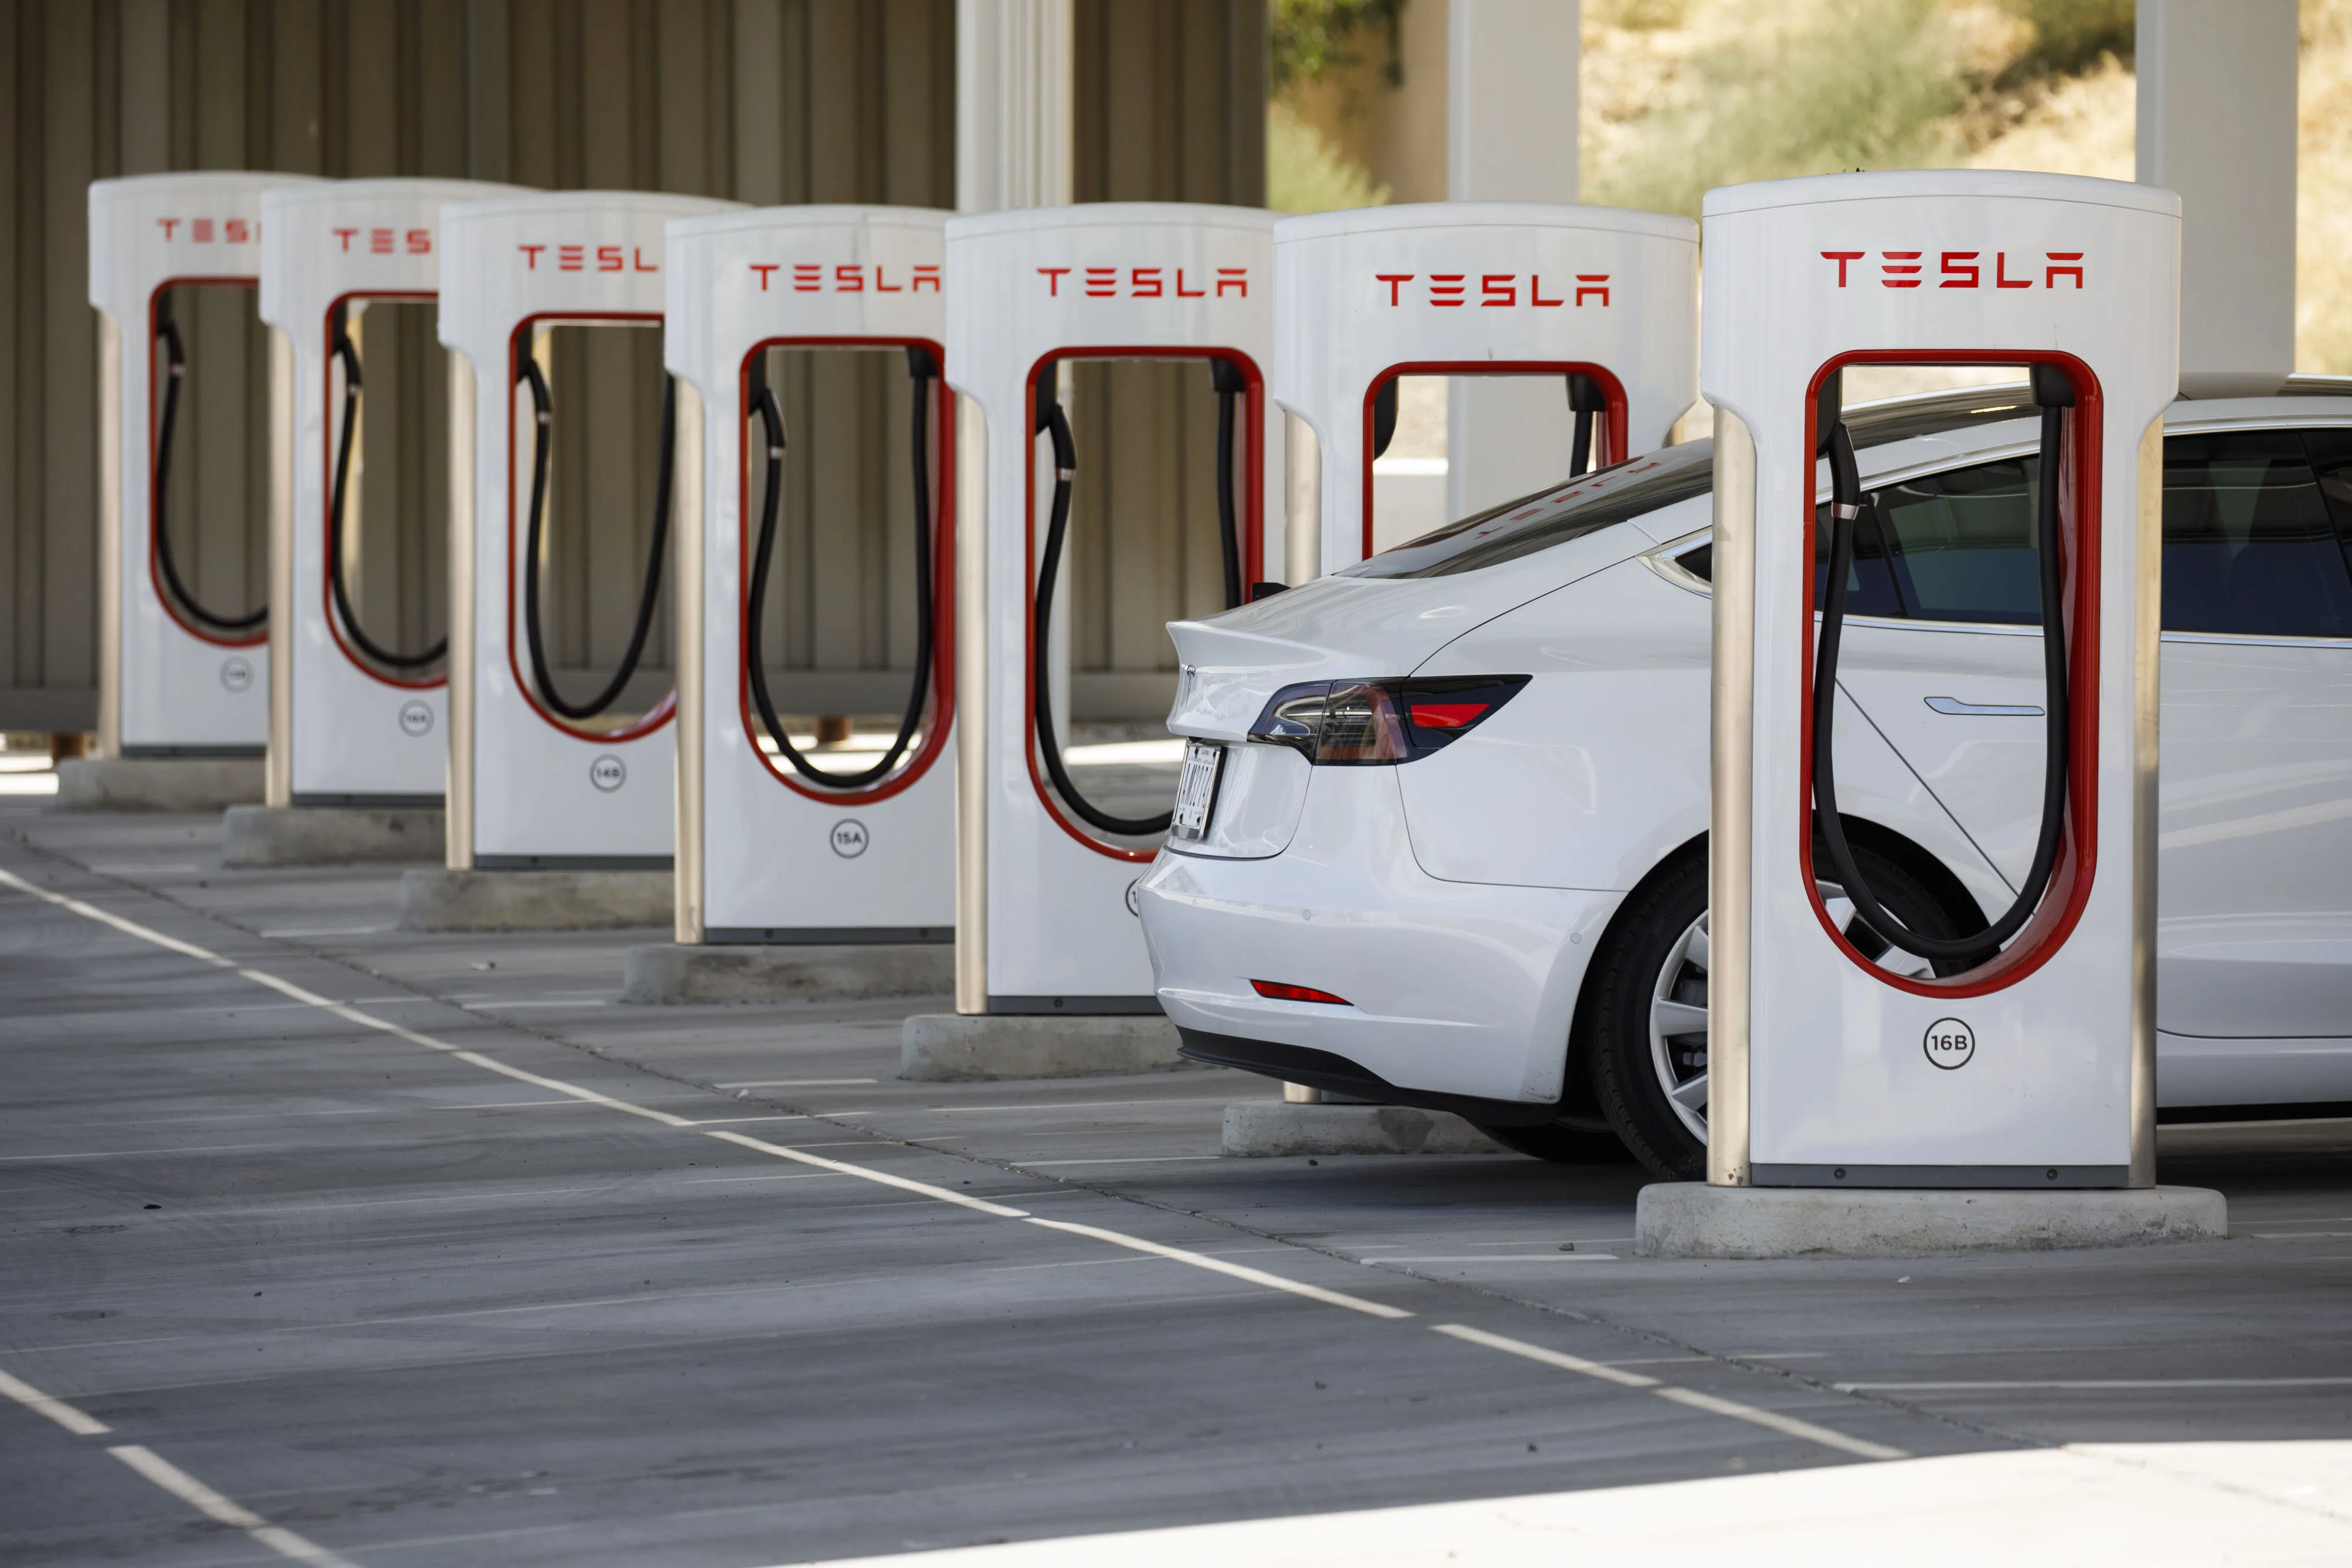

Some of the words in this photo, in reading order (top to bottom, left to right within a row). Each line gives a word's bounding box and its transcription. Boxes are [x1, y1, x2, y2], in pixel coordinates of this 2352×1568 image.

[157, 218, 261, 243] TES
[333, 228, 432, 255] TES
[518, 245, 659, 272] TESL
[1820, 251, 2084, 289] TESLA
[749, 264, 941, 293] TESLA
[1037, 268, 1248, 298] TESLA
[1375, 274, 1610, 307] TESLA
[837, 832, 863, 845] 15A
[1931, 1035, 1967, 1051] 16B
